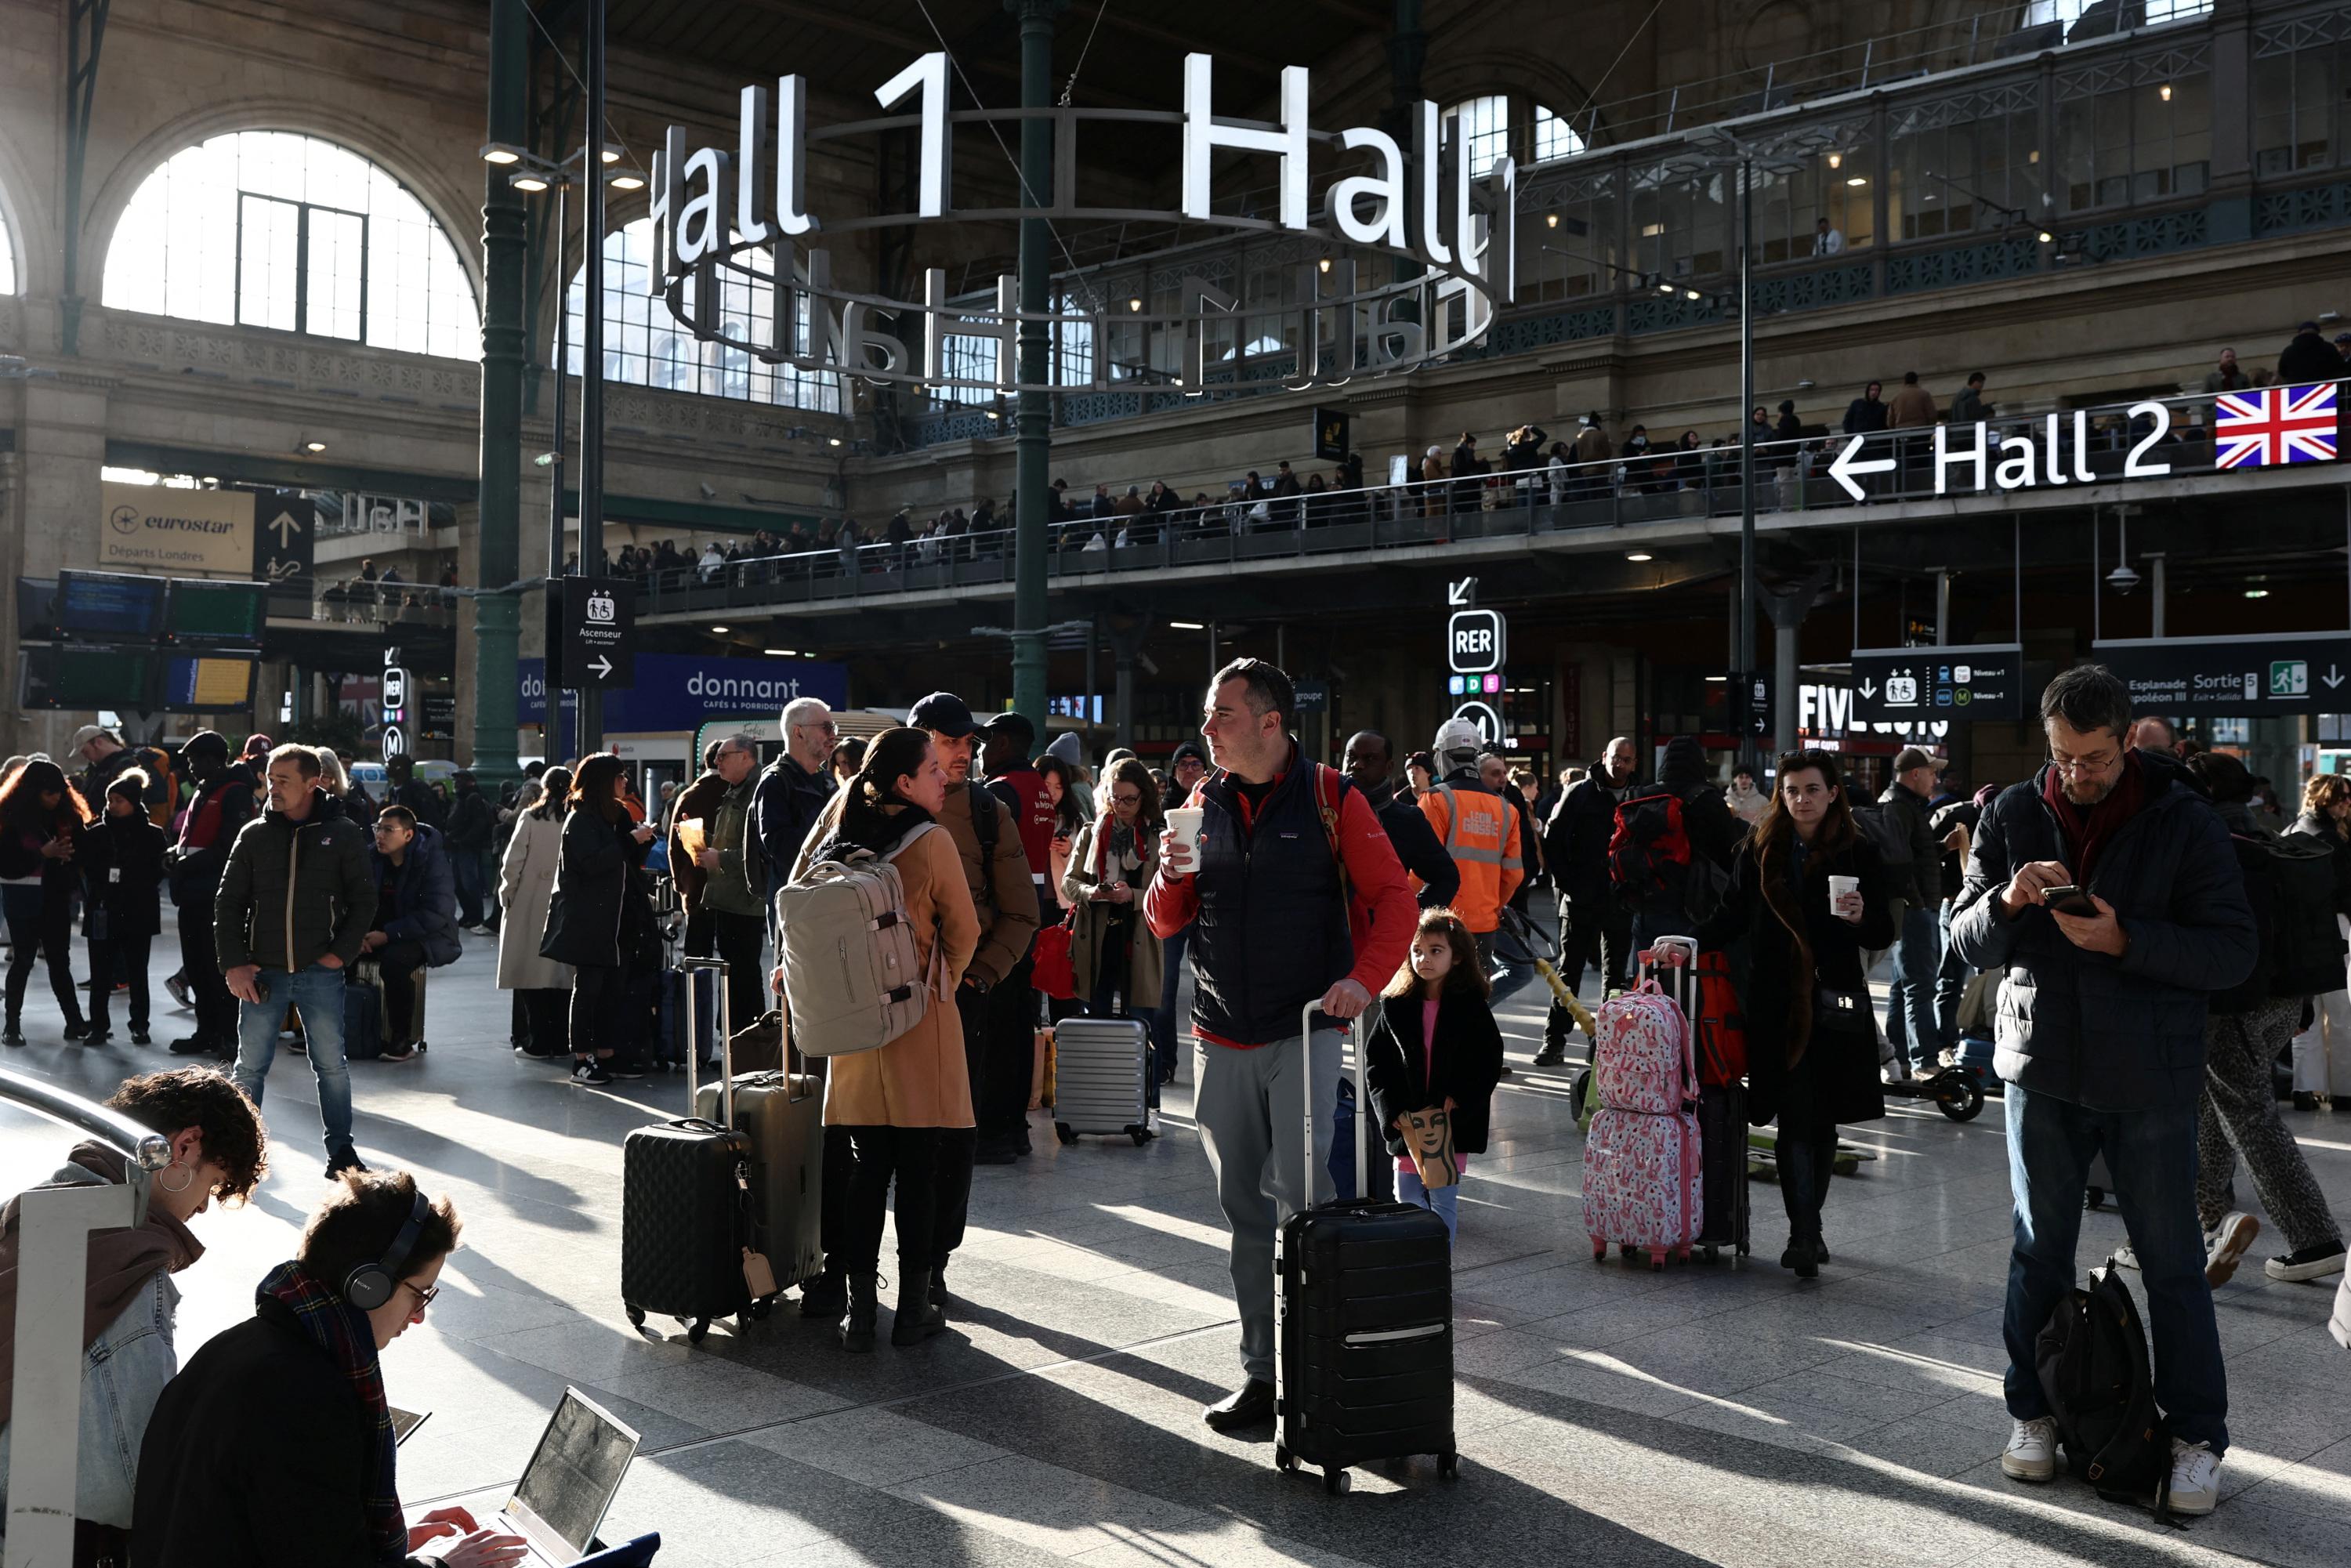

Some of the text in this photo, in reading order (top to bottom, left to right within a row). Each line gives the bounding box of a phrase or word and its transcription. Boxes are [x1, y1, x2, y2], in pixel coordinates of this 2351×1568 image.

[1182, 51, 1480, 276] Hall
[649, 51, 951, 296] Hall 1
[1934, 401, 2171, 494] Hall 2
[145, 515, 234, 534] eurostar
[109, 545, 205, 562] Départs Londres
[579, 628, 622, 639] Ascenseur
[1455, 629, 1491, 654] RER
[386, 680, 400, 697] RER
[686, 671, 800, 699] donnant
[1469, 679, 1479, 690] D
[1488, 678, 1495, 689] E
[2129, 679, 2186, 692] Esplanade
[2193, 674, 2255, 689] Sortie 5
[1295, 691, 1323, 703] groupe
[740, 701, 784, 712] PORRIDGES
[386, 734, 399, 756] M
[1804, 739, 1820, 749] FIVE
